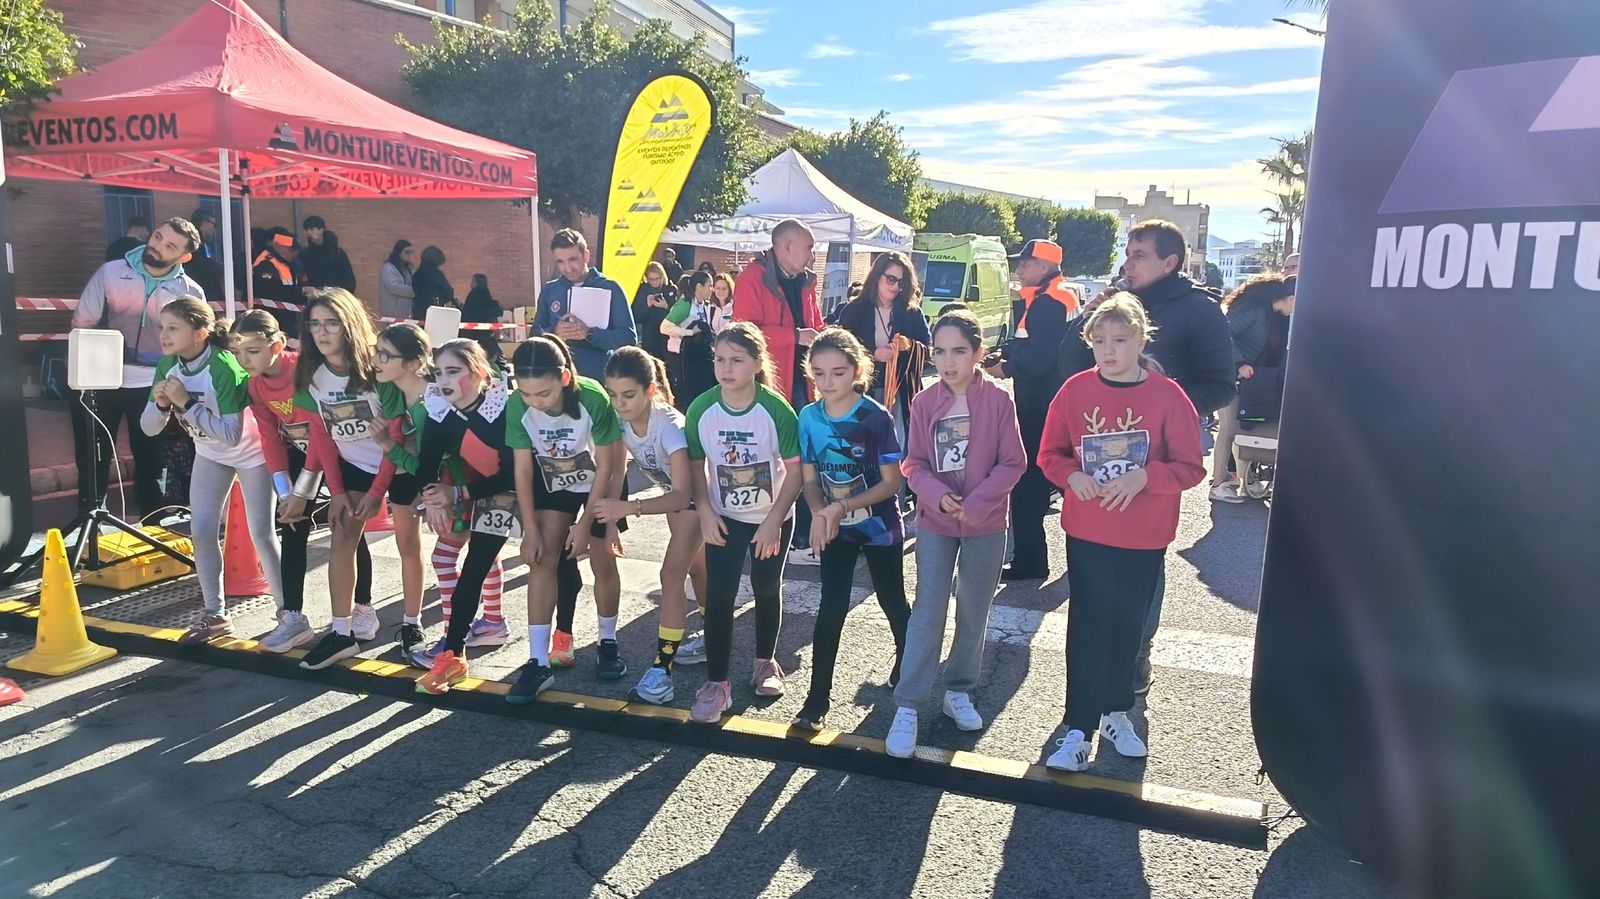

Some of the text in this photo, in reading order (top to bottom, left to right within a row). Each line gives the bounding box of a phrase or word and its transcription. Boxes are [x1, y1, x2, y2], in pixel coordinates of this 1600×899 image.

[303, 126, 513, 185] MONTUREVENTOS.COM
[335, 420, 367, 436] 305
[555, 470, 588, 487] 306
[730, 487, 761, 506] 327
[483, 511, 514, 530] 334
